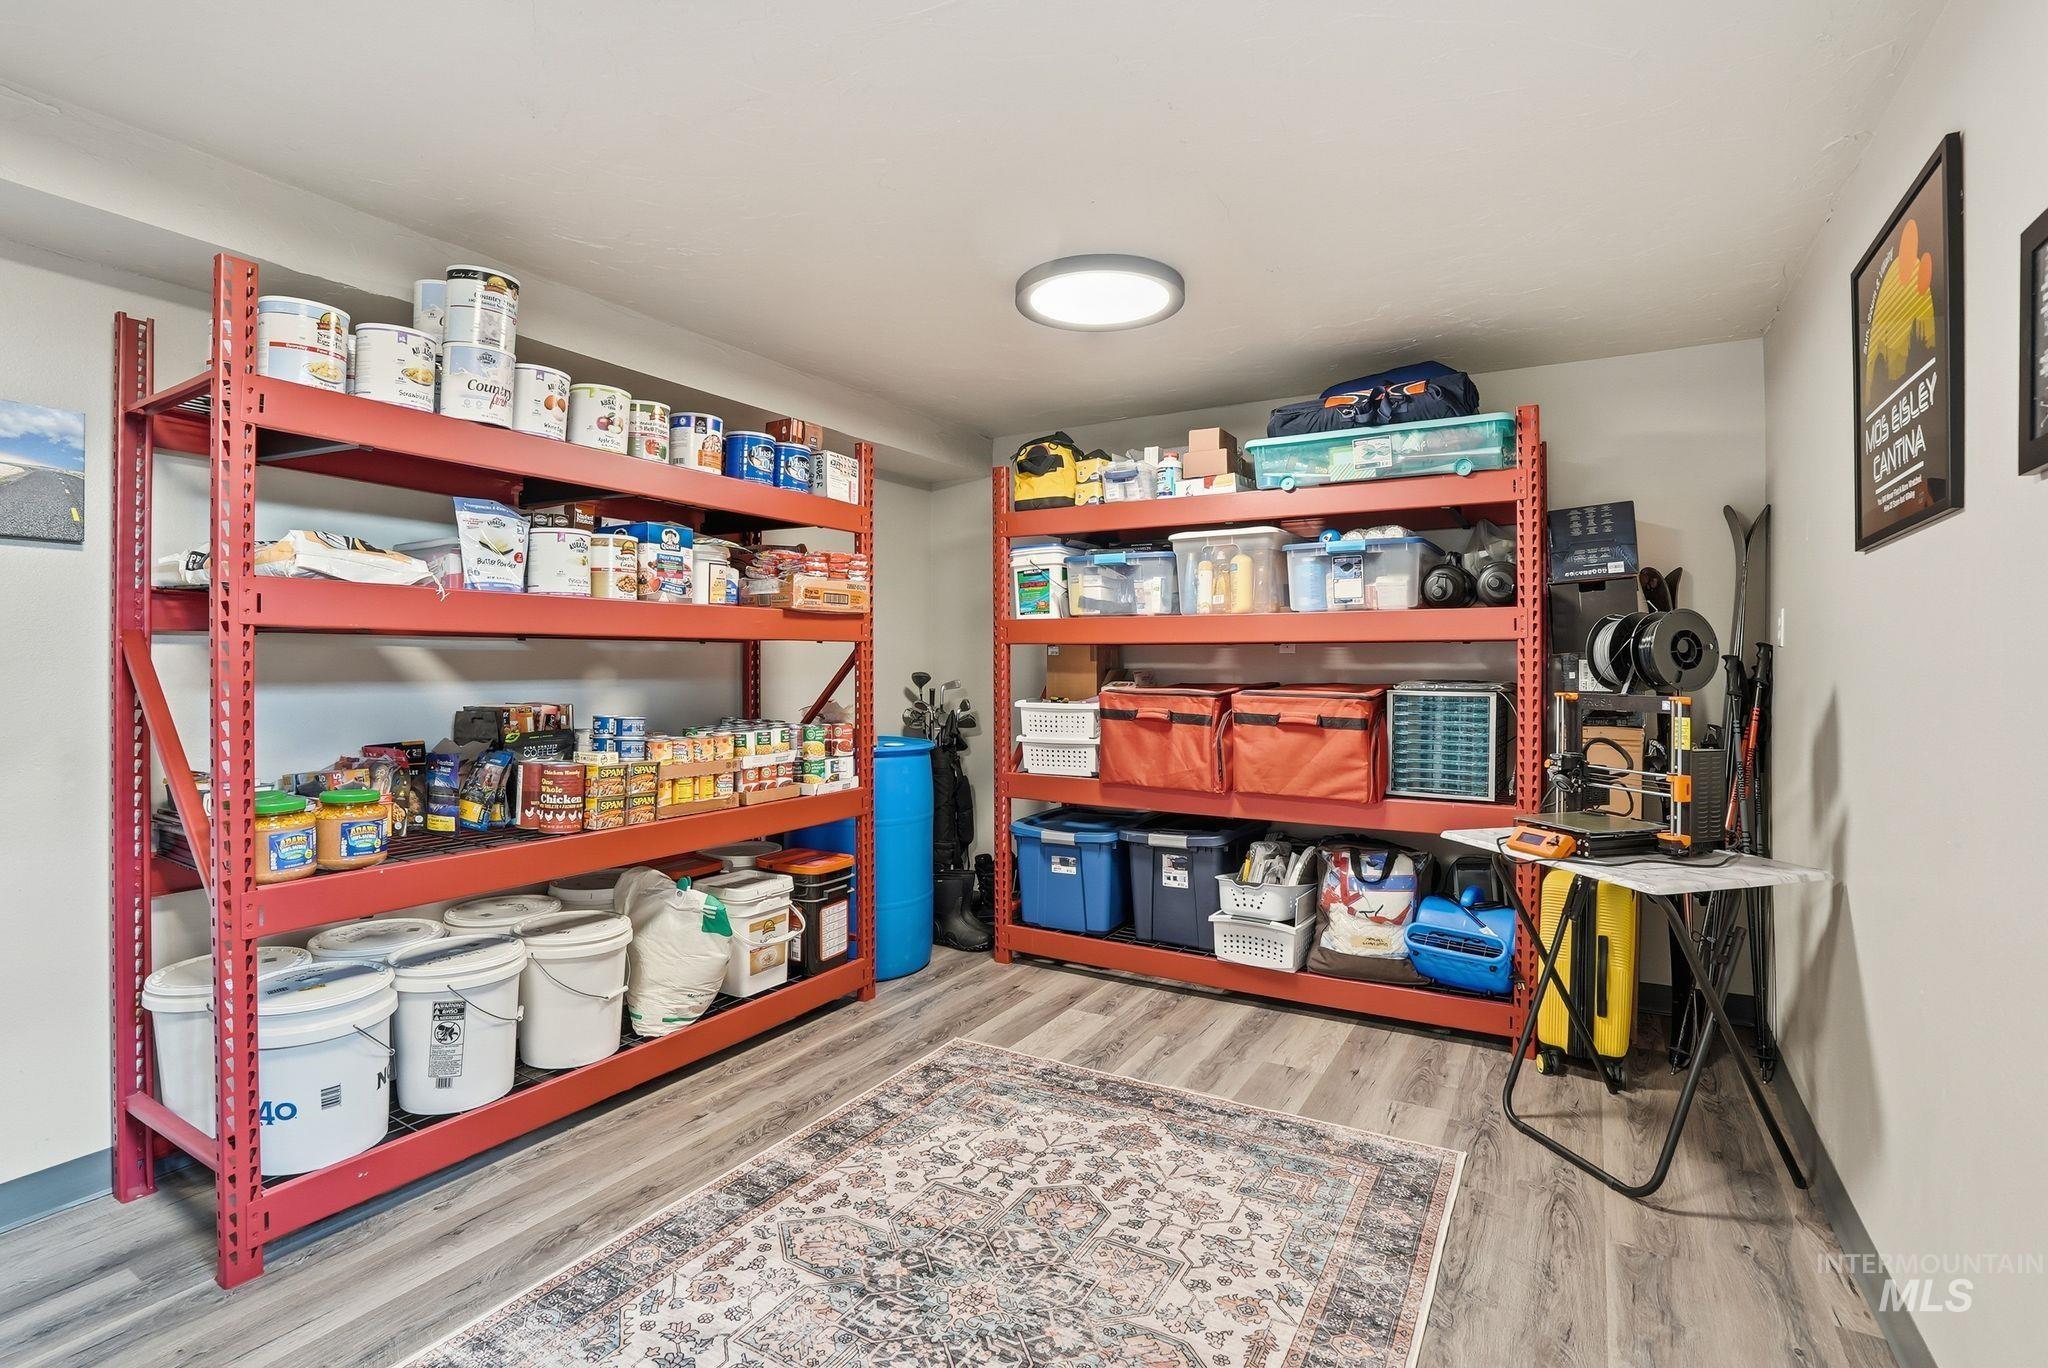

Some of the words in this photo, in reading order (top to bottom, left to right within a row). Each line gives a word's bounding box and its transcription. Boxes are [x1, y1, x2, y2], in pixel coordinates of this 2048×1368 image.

[467, 378, 513, 402] Country
[1865, 413, 1889, 455] MOS
[1891, 371, 1938, 434] EISLEY
[1873, 424, 1927, 483] CANTINA
[476, 557, 496, 566] Butter
[600, 768, 625, 779] SPAM
[634, 765, 657, 776] SPAM
[541, 778, 554, 786] One
[541, 785, 563, 793] Whole
[540, 793, 582, 804] Chicken
[632, 796, 656, 807] SPAM
[600, 800, 625, 811] SPAM
